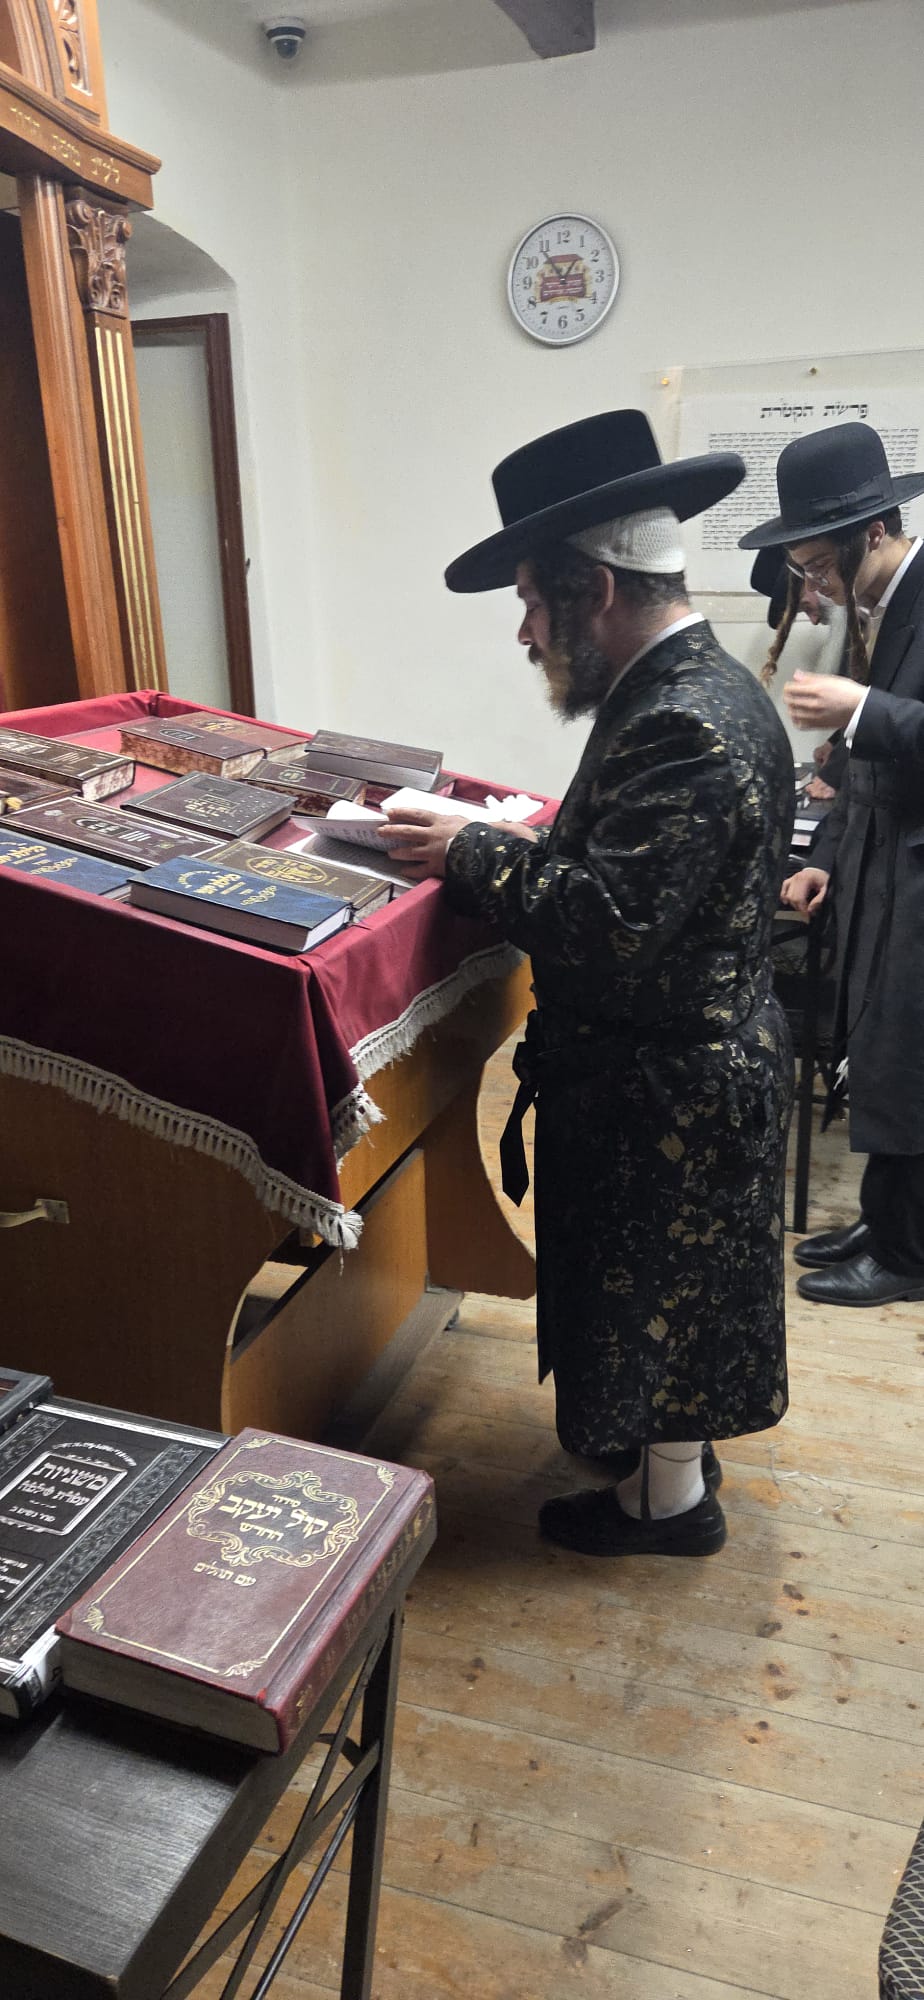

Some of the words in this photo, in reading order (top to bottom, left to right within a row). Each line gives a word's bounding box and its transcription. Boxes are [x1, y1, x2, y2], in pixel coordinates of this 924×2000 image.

[557, 230, 570, 244] 12
[580, 235, 585, 248] 1
[539, 239, 550, 253] 11
[525, 256, 539, 270] 10
[591, 249, 600, 263] 2
[522, 276, 532, 290] 9
[595, 270, 604, 283] 3
[527, 296, 537, 310] 8
[589, 292, 597, 304] 4
[540, 311, 548, 324] 7
[576, 308, 585, 321] 5
[558, 315, 568, 329] 6
[823, 403, 867, 418] פרשת
[32, 1462, 108, 1491] משניות
[219, 1494, 282, 1520] יעקב
[272, 1494, 301, 1507] סידור
[285, 1508, 329, 1539] קול
[240, 1522, 284, 1542] החדש
[193, 1561, 234, 1580] תהלים
[233, 1575, 257, 1587] עם
